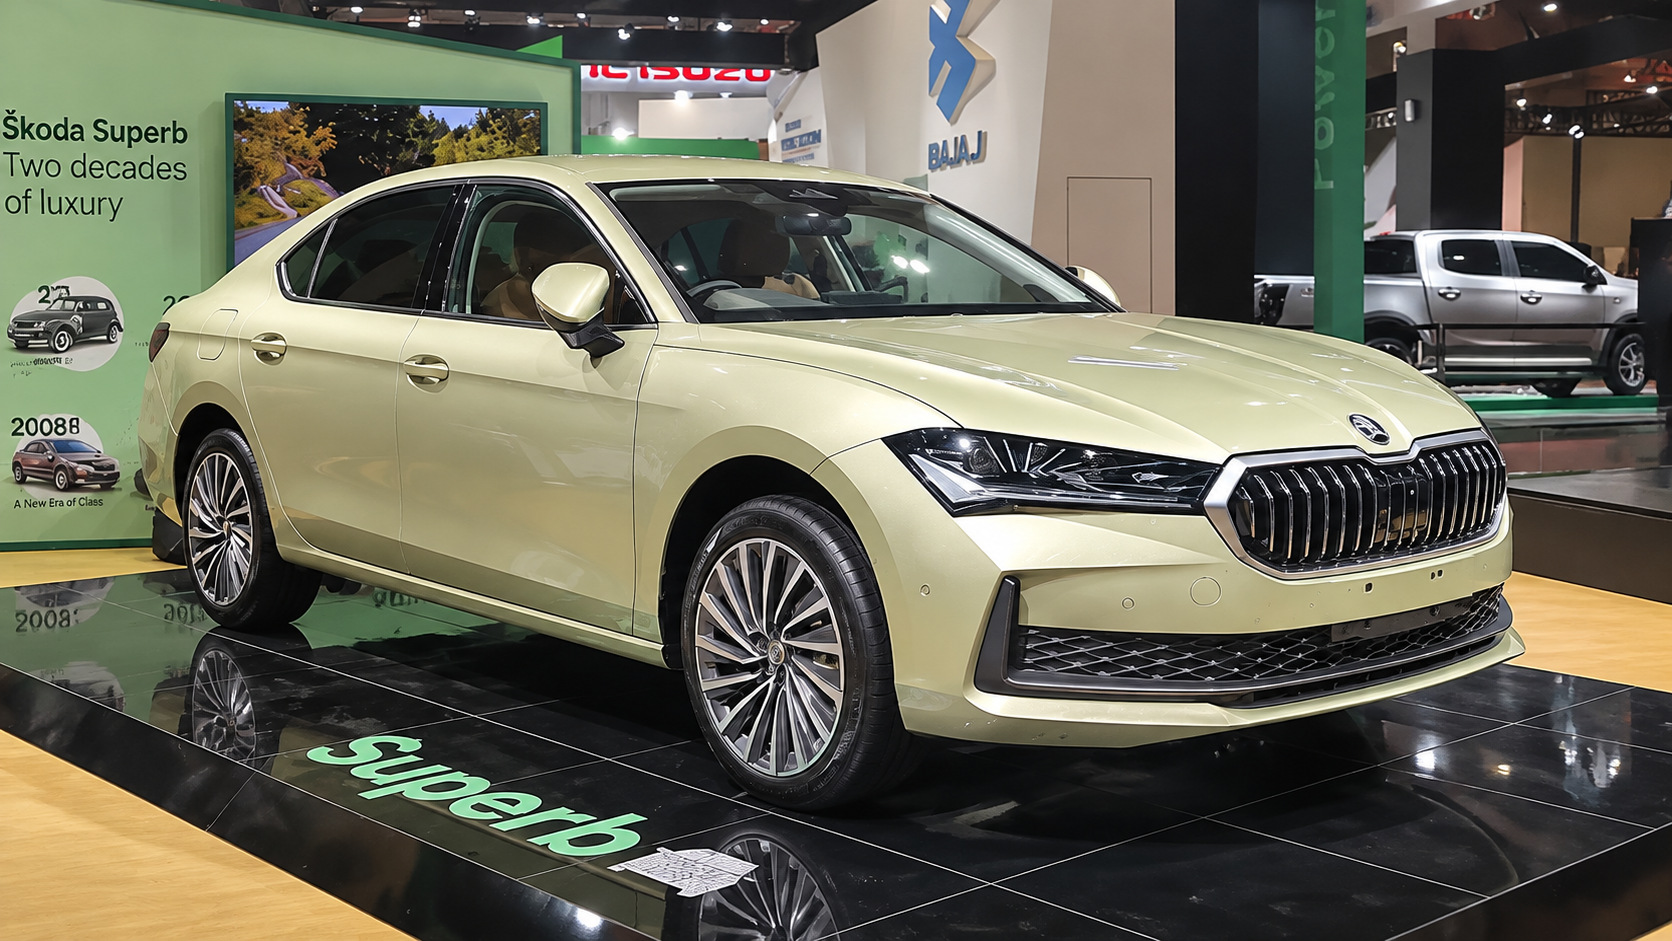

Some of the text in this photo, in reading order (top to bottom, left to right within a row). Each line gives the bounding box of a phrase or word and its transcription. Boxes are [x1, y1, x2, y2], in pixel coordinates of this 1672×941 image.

[2, 109, 188, 148] Škoda Superb
[3, 151, 187, 181] Two decades
[928, 130, 985, 171] BAJAJ
[5, 187, 124, 222] of luxury
[13, 496, 104, 509] A New Era of Class
[306, 735, 648, 856] Superb
